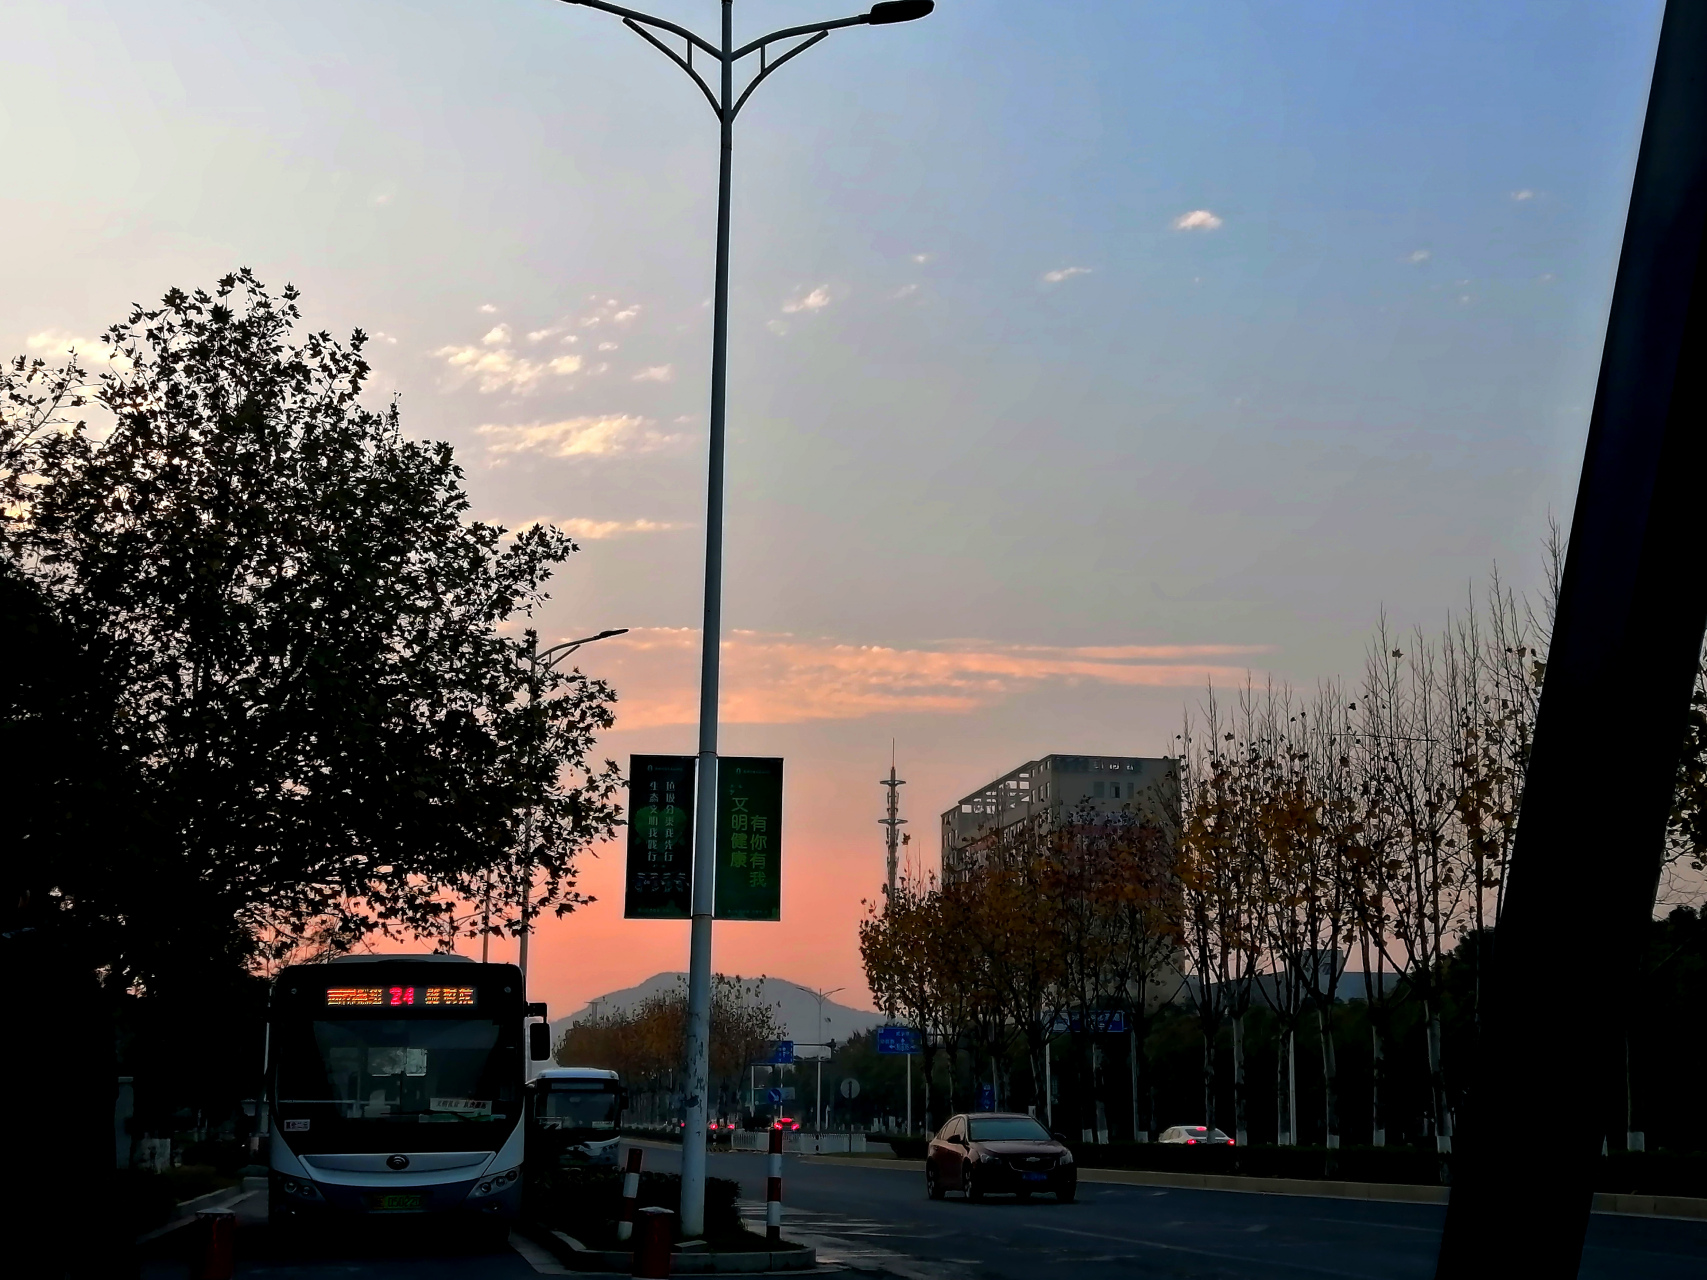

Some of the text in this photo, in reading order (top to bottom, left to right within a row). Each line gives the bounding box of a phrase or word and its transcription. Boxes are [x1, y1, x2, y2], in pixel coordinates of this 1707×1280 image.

[648, 781, 658, 861] 生态文明我践行
[664, 781, 674, 861] 垃圾分类我先行
[730, 797, 748, 868] 文明健康
[749, 815, 768, 887] 有你有我
[389, 987, 414, 1006] 24
